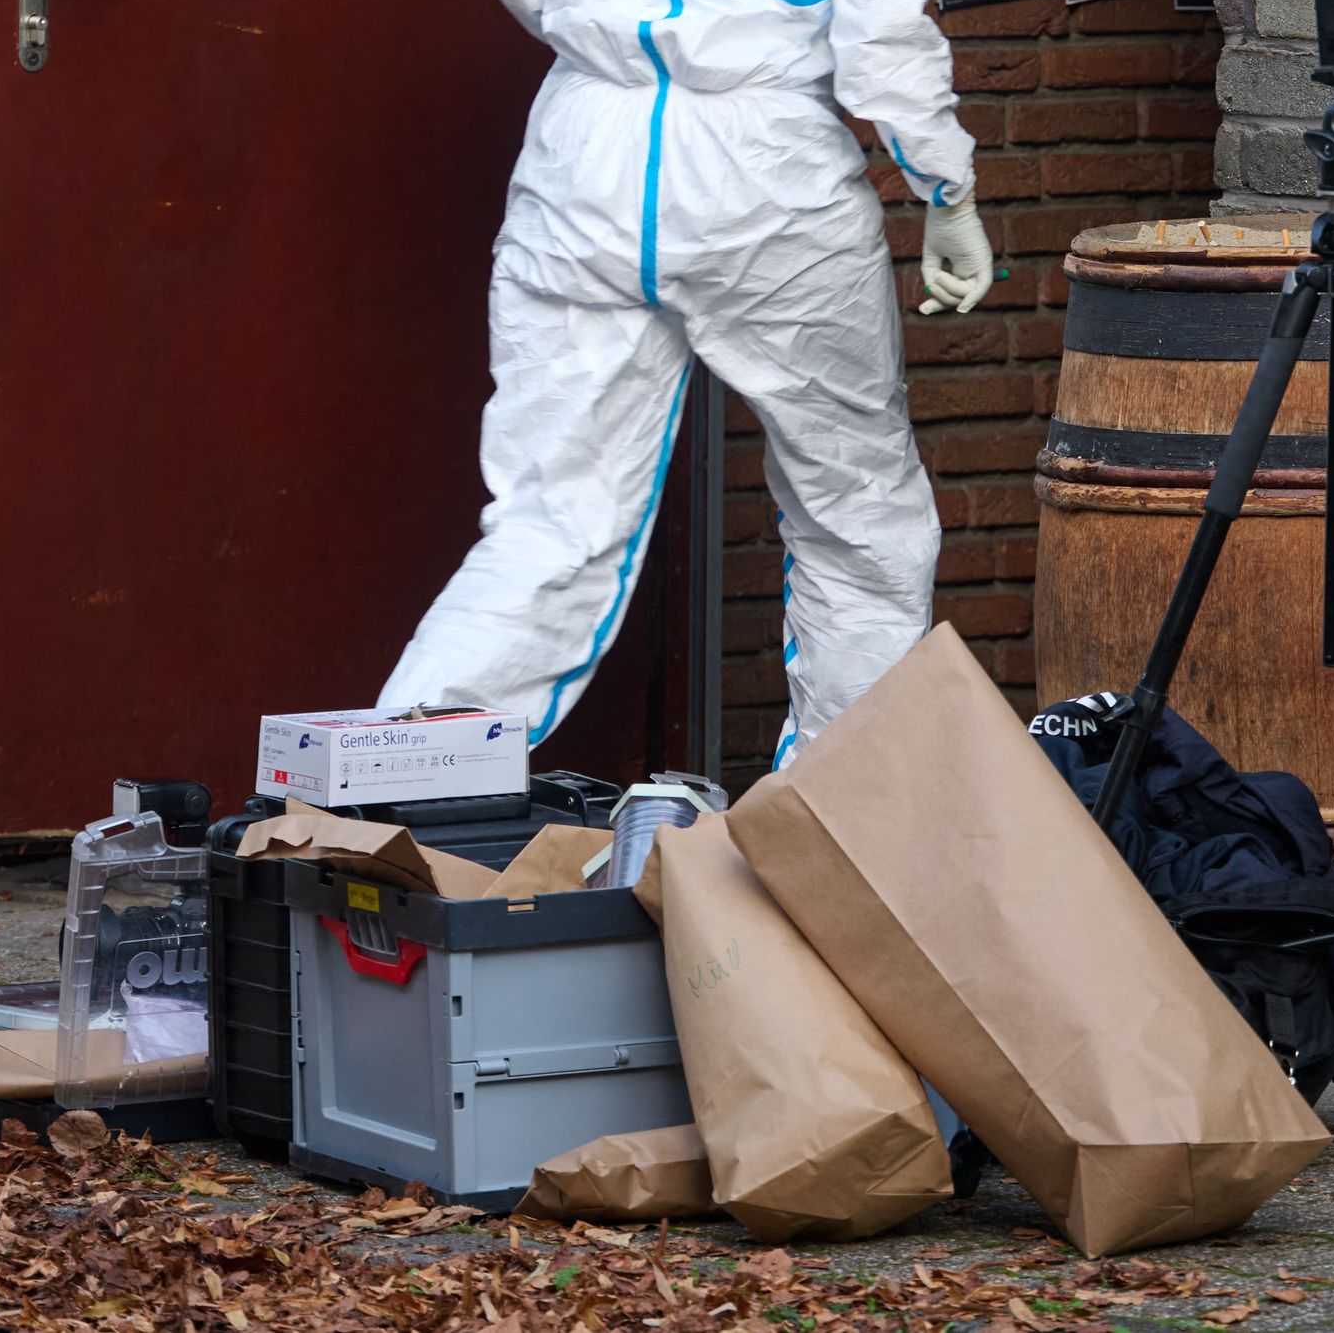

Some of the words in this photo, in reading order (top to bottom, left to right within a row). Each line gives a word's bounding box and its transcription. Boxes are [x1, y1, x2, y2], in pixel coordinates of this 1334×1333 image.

[340, 730, 380, 749] Gentle
[382, 730, 409, 746] Skin
[411, 733, 427, 747] grip
